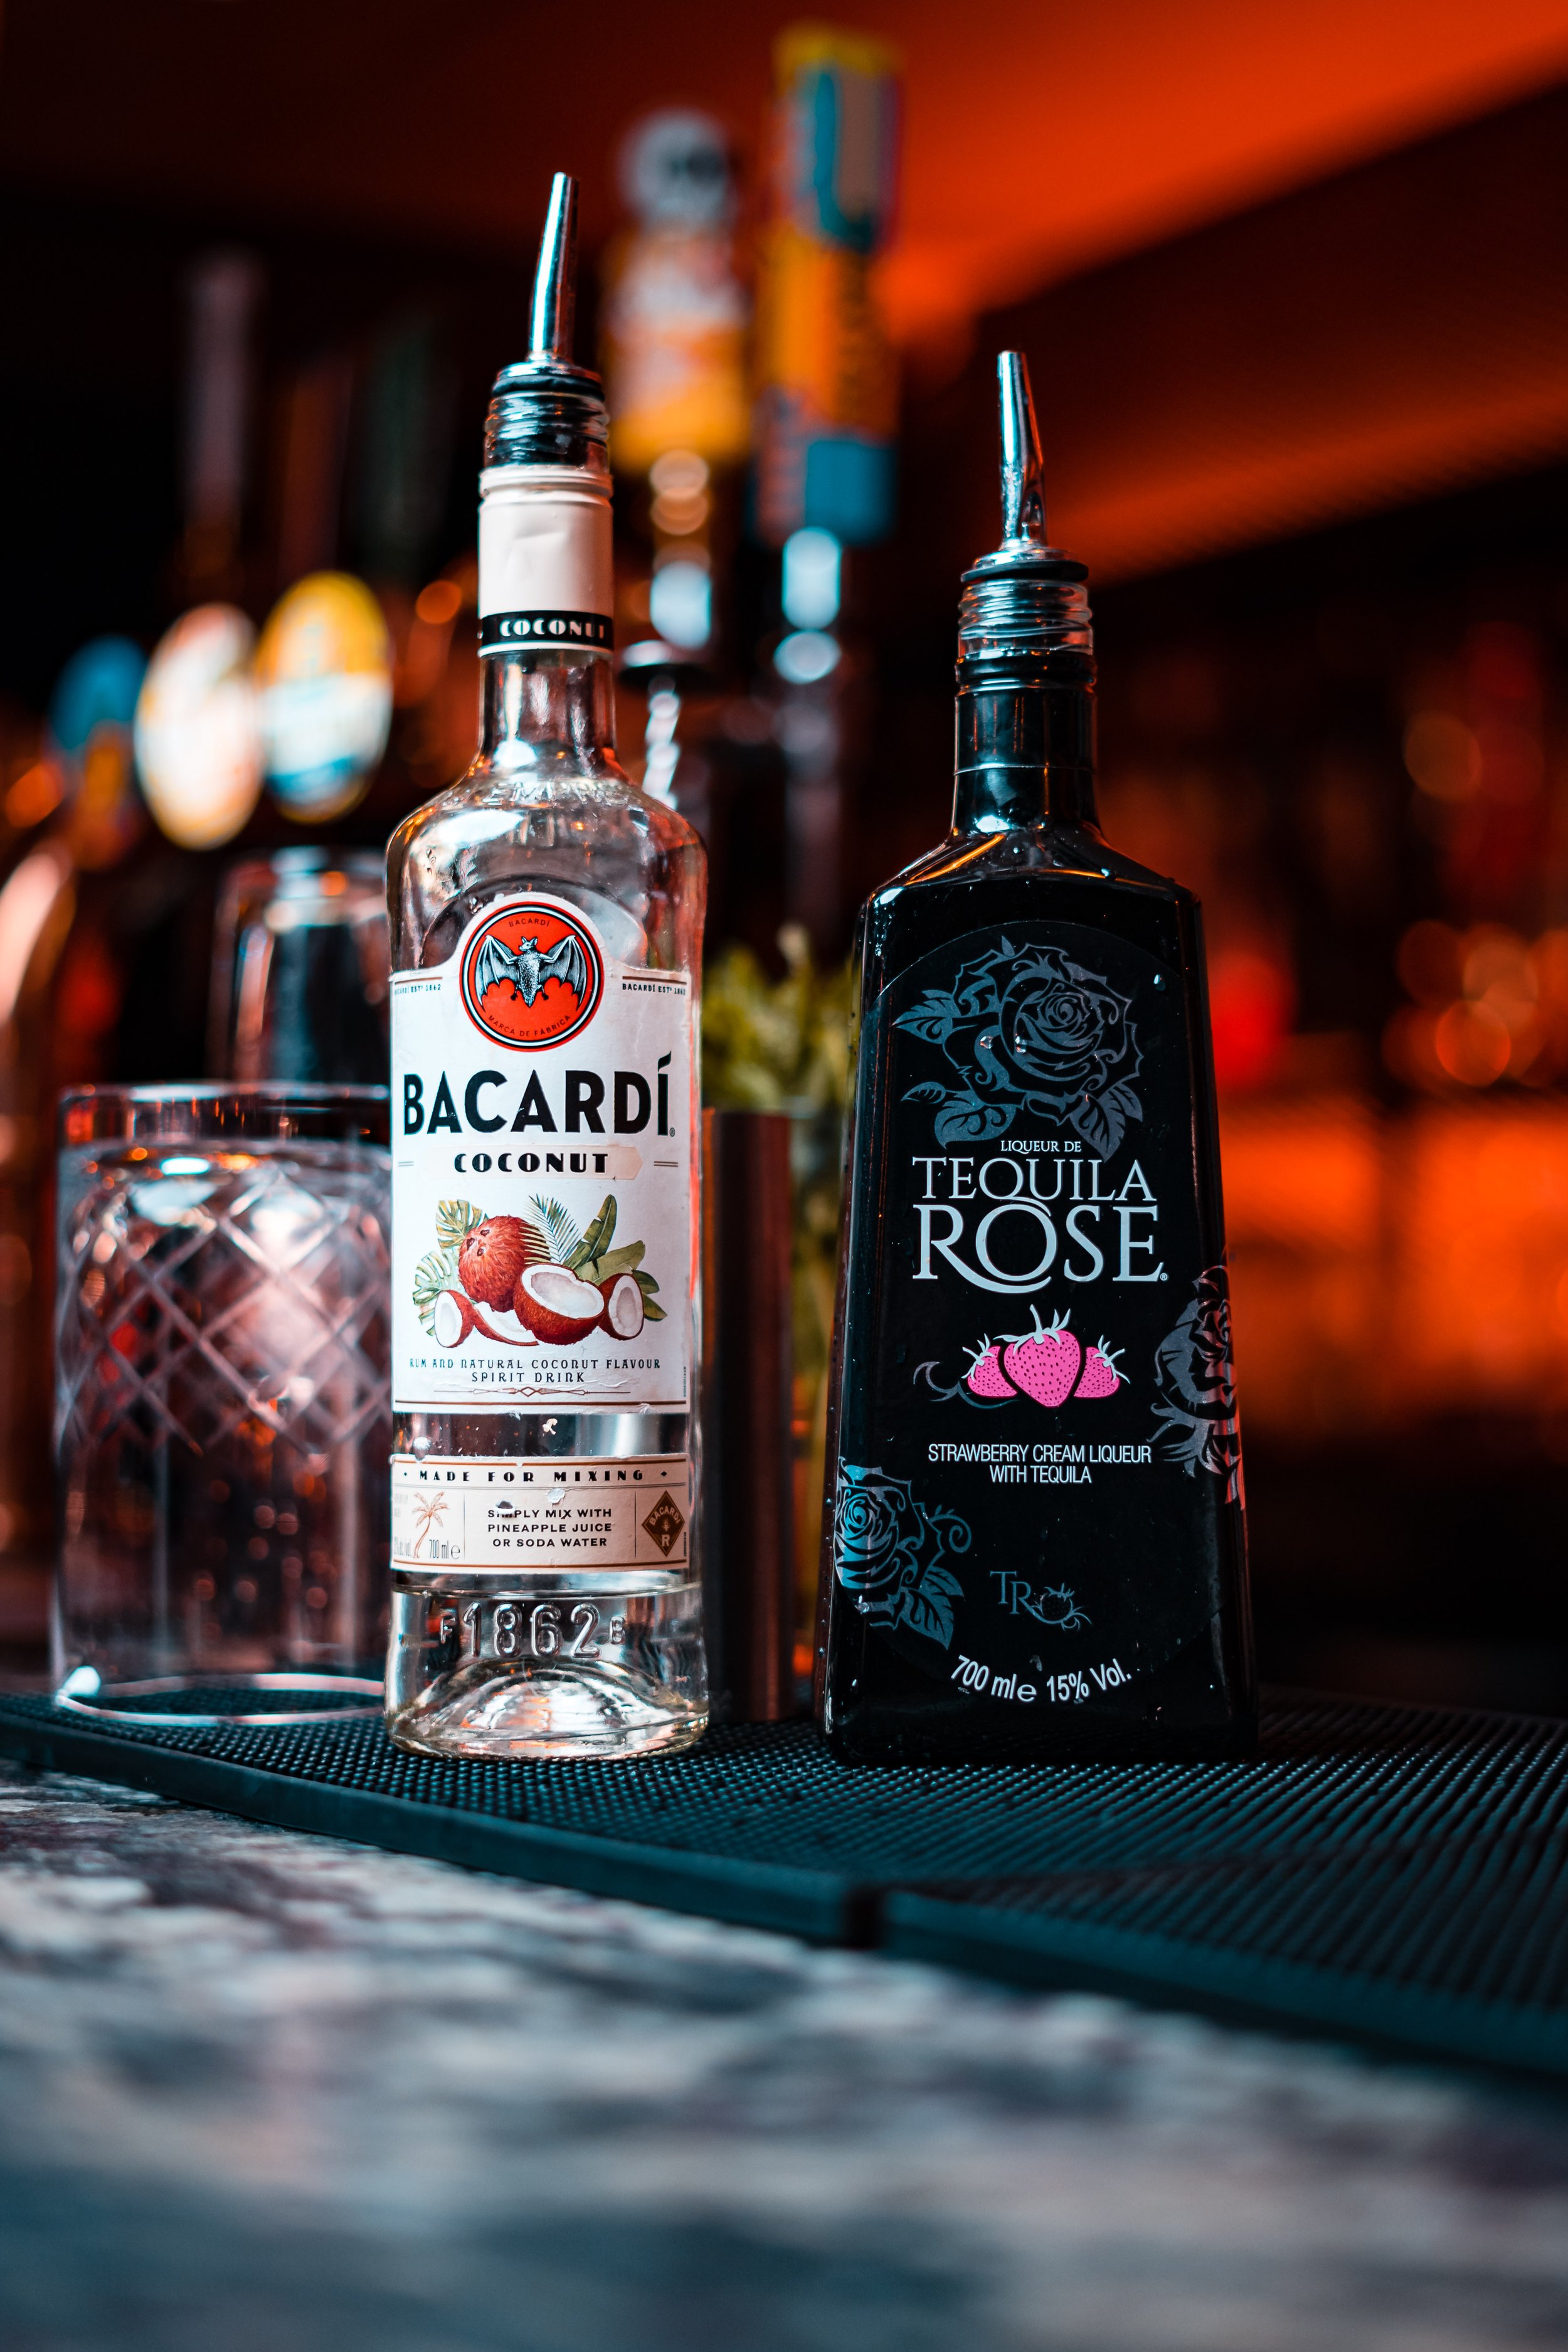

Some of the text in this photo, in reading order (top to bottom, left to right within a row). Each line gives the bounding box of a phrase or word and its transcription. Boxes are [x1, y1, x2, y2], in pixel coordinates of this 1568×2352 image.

[500, 618, 605, 638] COCONUT
[509, 918, 550, 927] BACARDÍ
[426, 983, 441, 992] 1862
[622, 983, 655, 992] BACARDÍ
[489, 1015, 515, 1035] MARCA
[534, 1015, 571, 1036] FÁBRICA
[404, 1051, 672, 1136] BACARDÍ
[1000, 1140, 1081, 1155] LIQUEUR DE
[454, 1153, 608, 1173] COCONUT
[912, 1157, 1157, 1217] TEQUILA
[912, 1202, 1165, 1294] ROSE
[410, 1359, 660, 1369] RUM AND NATURAL COCONUT FLAVOUR
[472, 1372, 585, 1382] SPIRIT DRINK
[928, 1443, 1152, 1463] STRAWBERRY CREAM LIQUEUR
[420, 1469, 643, 1482] MADE FOR MIXING
[989, 1465, 1092, 1483] WITH TEQUILA
[546, 1510, 572, 1519] MIX
[577, 1509, 612, 1517] WITH
[488, 1523, 612, 1533] PINEAPPLE JUICE
[492, 1538, 607, 1547] OR SODA WATER
[662, 1534, 670, 1547] R
[429, 1539, 440, 1559] 700
[442, 1540, 449, 1559] ml
[463, 1601, 601, 1659] 1862
[951, 1655, 989, 1691] 700
[1047, 1671, 1089, 1702] 15%
[1089, 1658, 1131, 1690] Vol.
